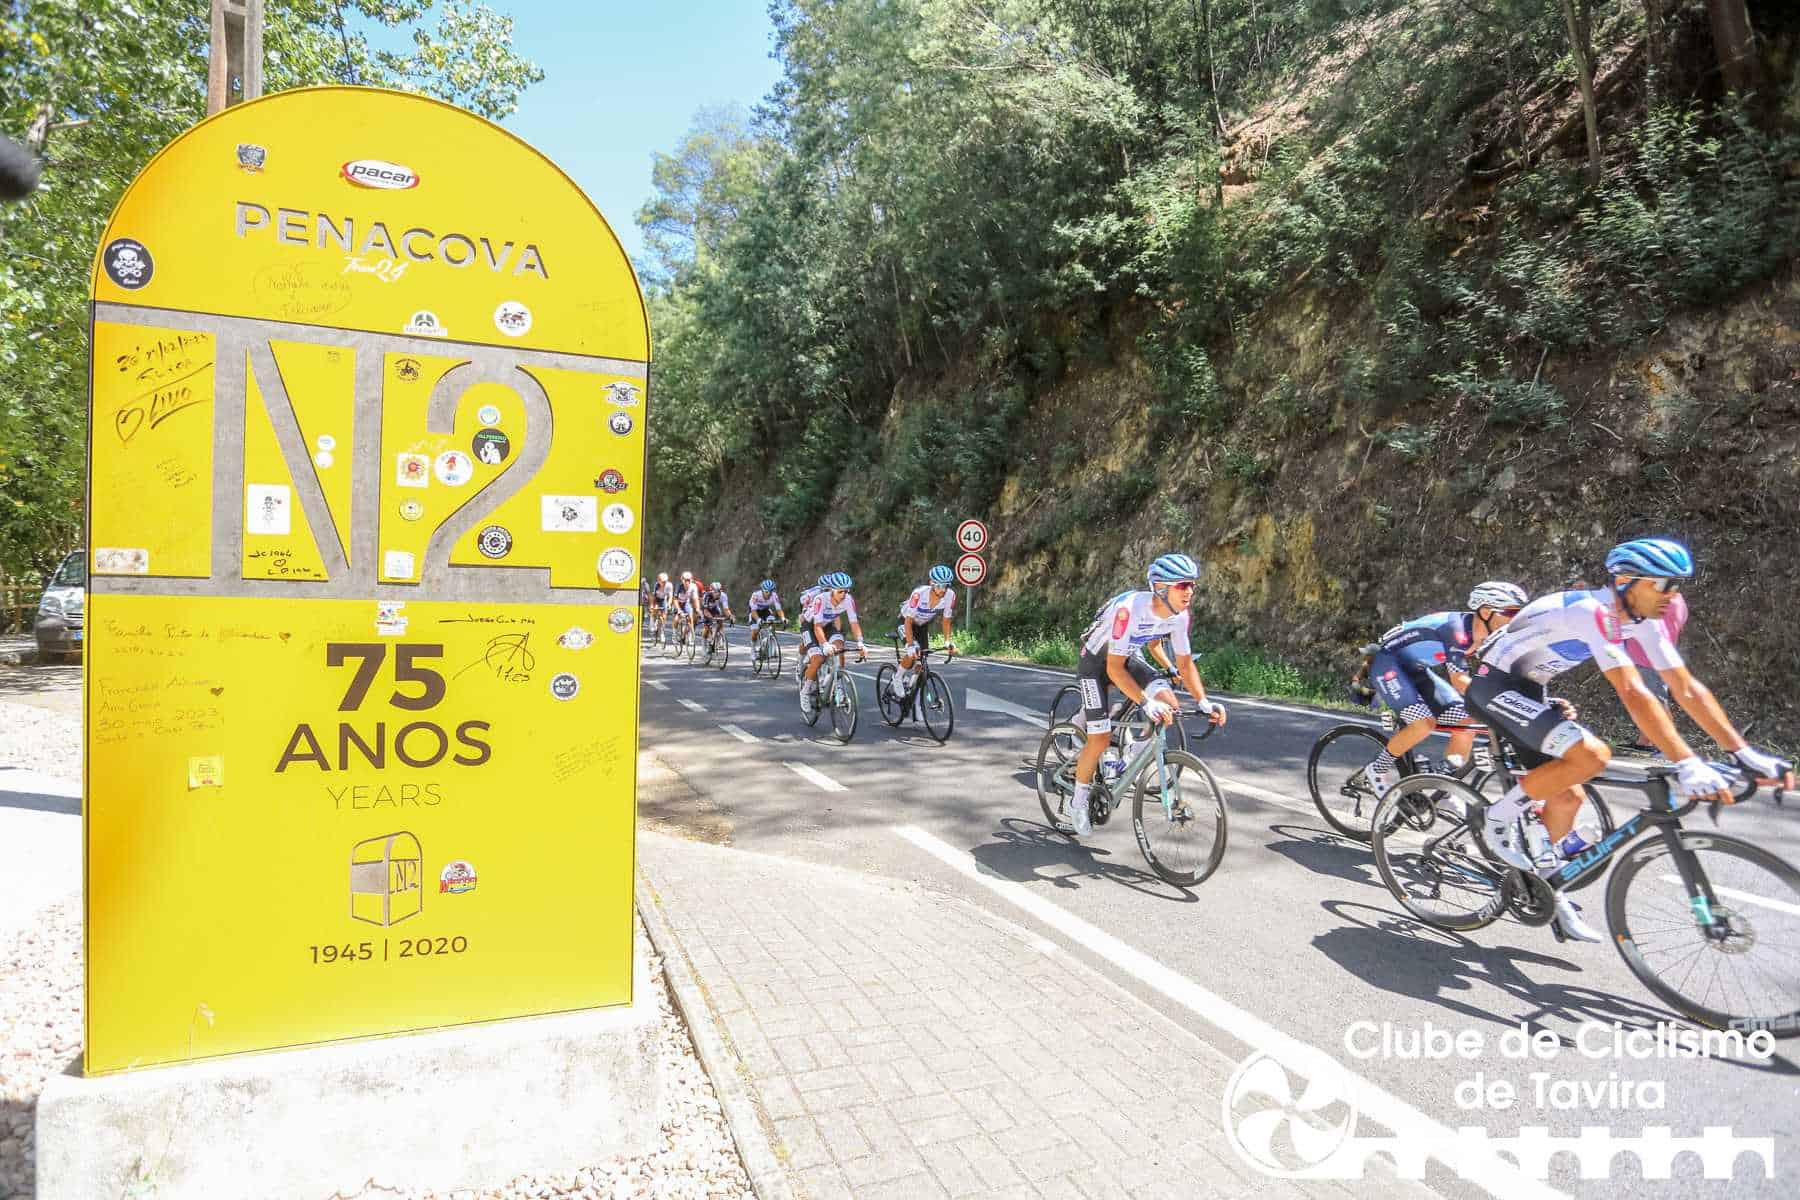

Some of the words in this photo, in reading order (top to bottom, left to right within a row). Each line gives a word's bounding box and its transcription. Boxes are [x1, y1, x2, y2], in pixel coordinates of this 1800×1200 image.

[351, 165, 415, 183] pacar
[235, 200, 550, 280] PENACOVA
[963, 530, 982, 543] 40
[326, 643, 447, 712] 75
[274, 719, 492, 773] ANOS
[327, 783, 442, 810] YEARS
[1560, 815, 1643, 881] SWIFT
[310, 942, 374, 964] 1945
[400, 935, 468, 958] 2020
